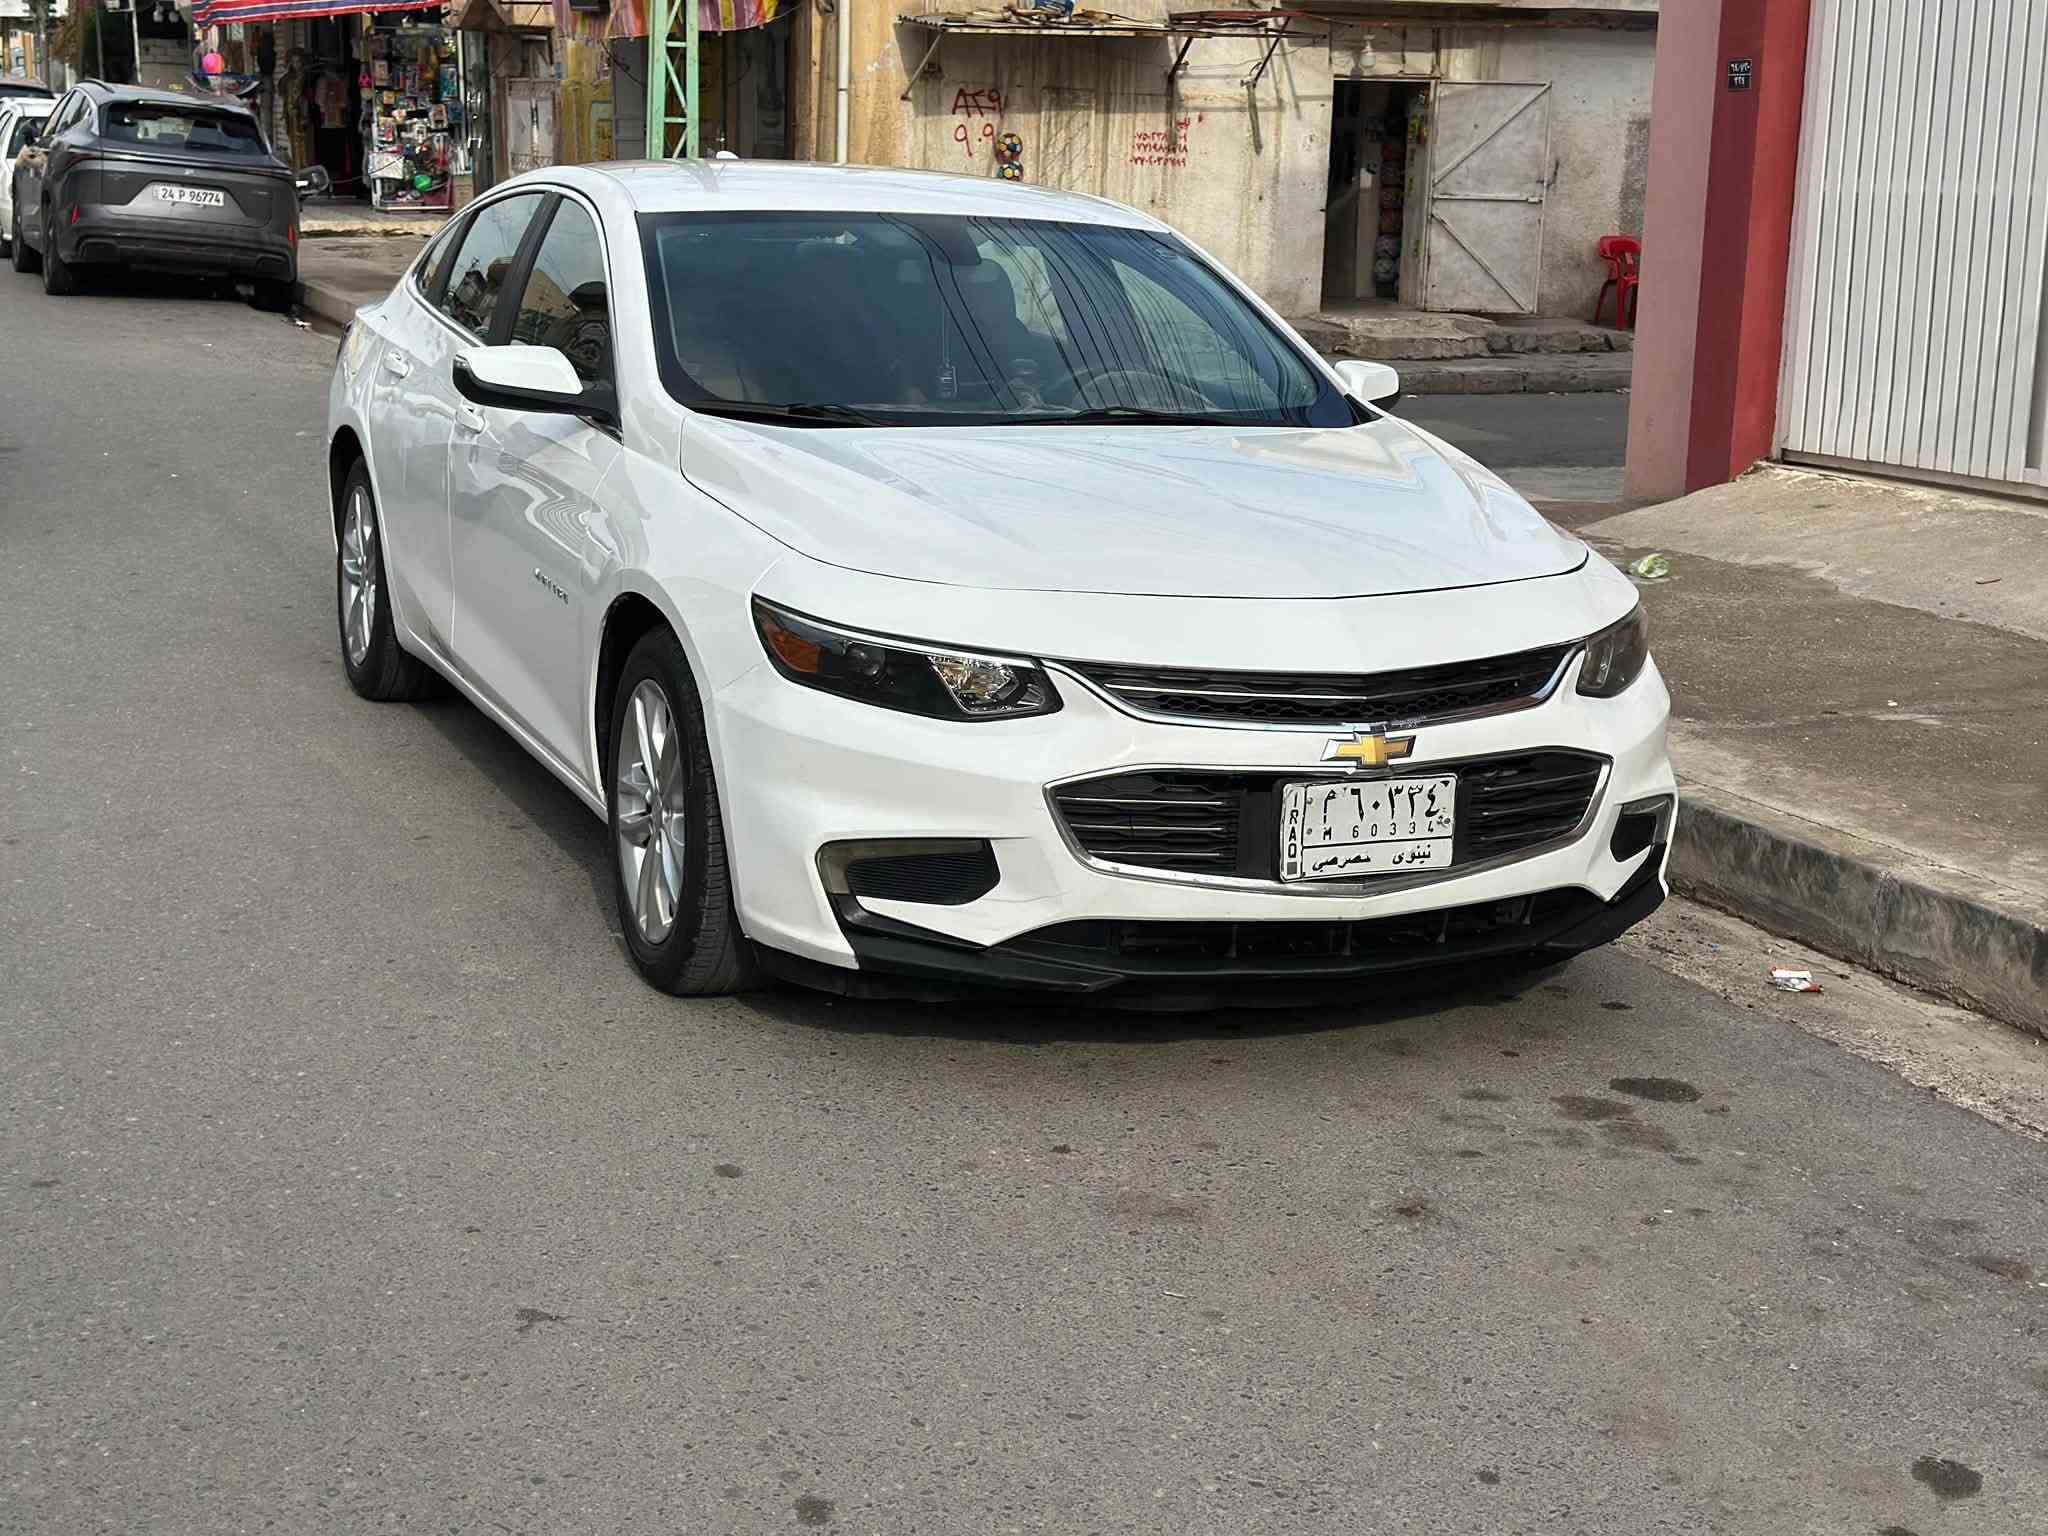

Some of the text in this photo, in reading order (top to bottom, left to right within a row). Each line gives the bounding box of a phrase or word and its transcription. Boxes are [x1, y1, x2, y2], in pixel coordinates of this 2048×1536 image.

[161, 188, 174, 199] 24
[179, 190, 186, 200] P
[189, 191, 221, 203] 96774
[1350, 784, 1440, 822] ٦٠٣٣٤
[1287, 791, 1299, 859] IRAQ
[1352, 821, 1435, 839] 60334
